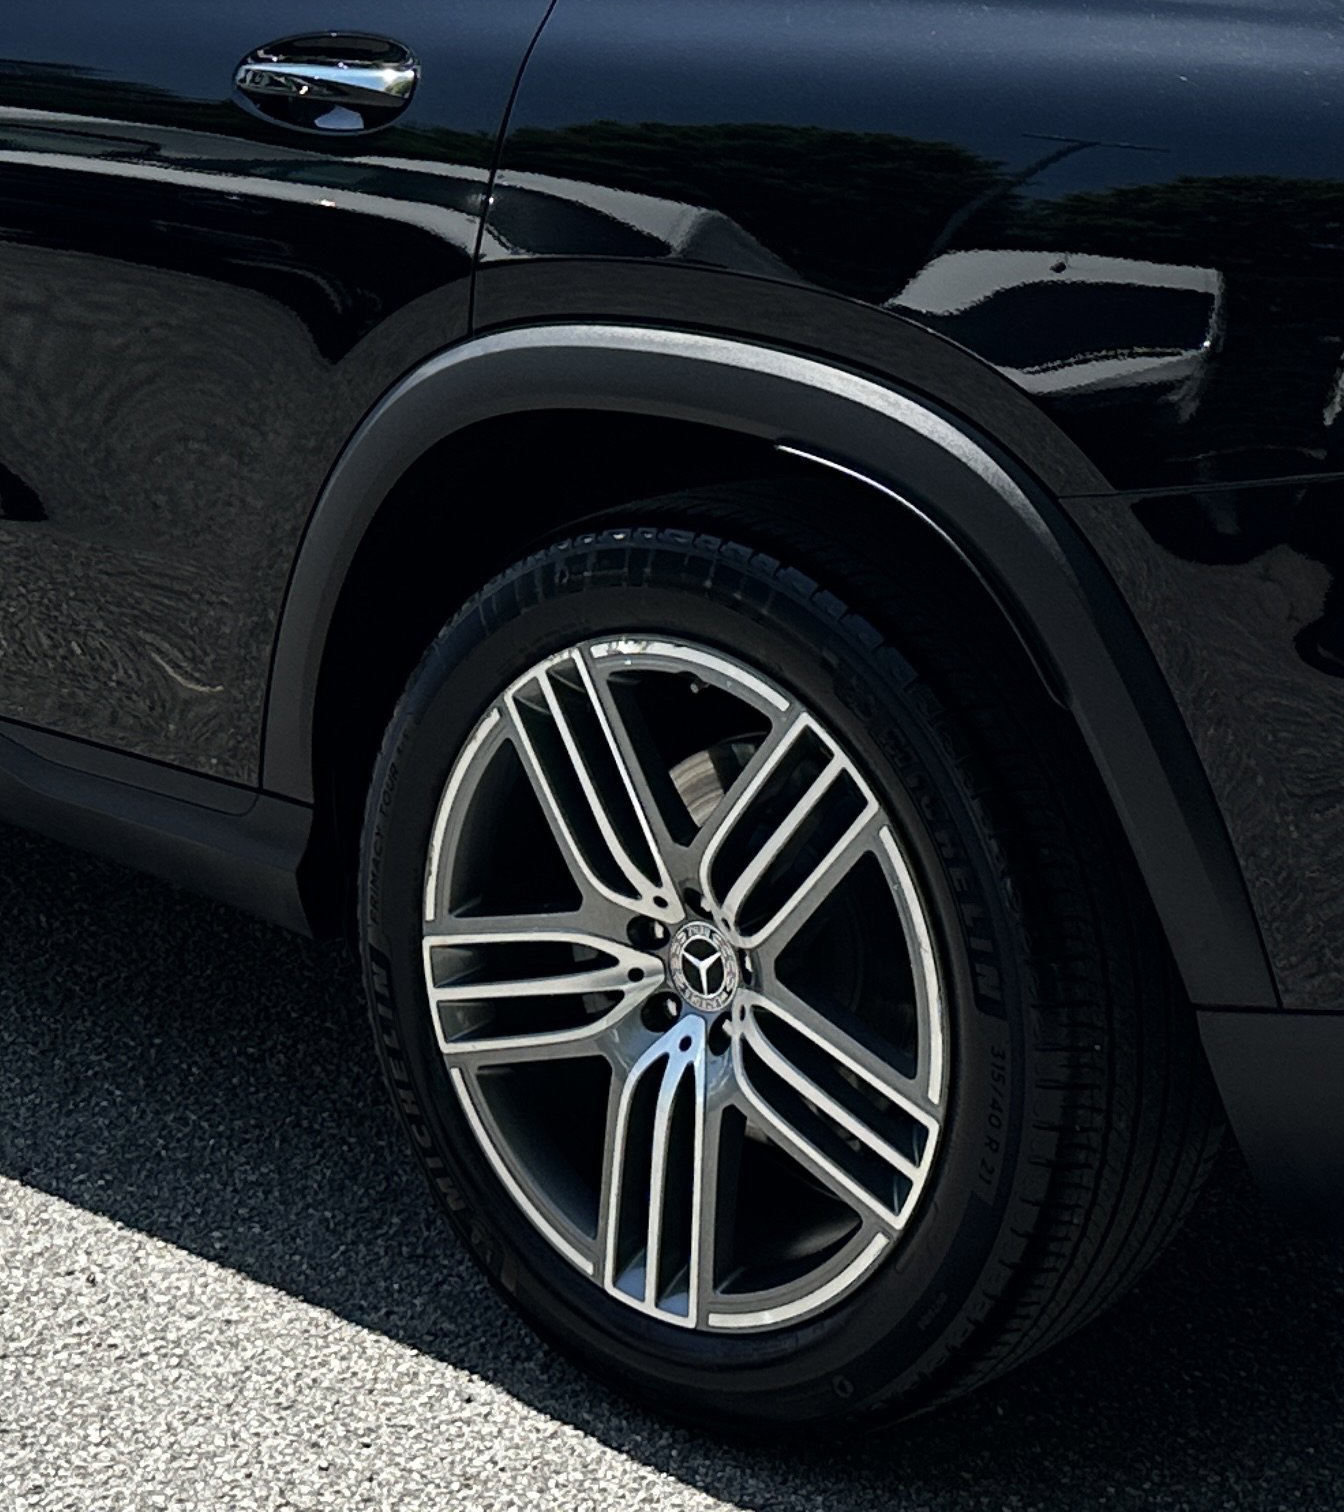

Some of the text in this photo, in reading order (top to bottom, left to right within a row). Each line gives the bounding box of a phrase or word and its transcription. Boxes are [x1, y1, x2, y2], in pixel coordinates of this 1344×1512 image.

[368, 761, 400, 926] PRIMACY TOUR
[369, 959, 467, 1212] MICHELIN
[978, 1045, 1006, 1185] 315/40 R 21
